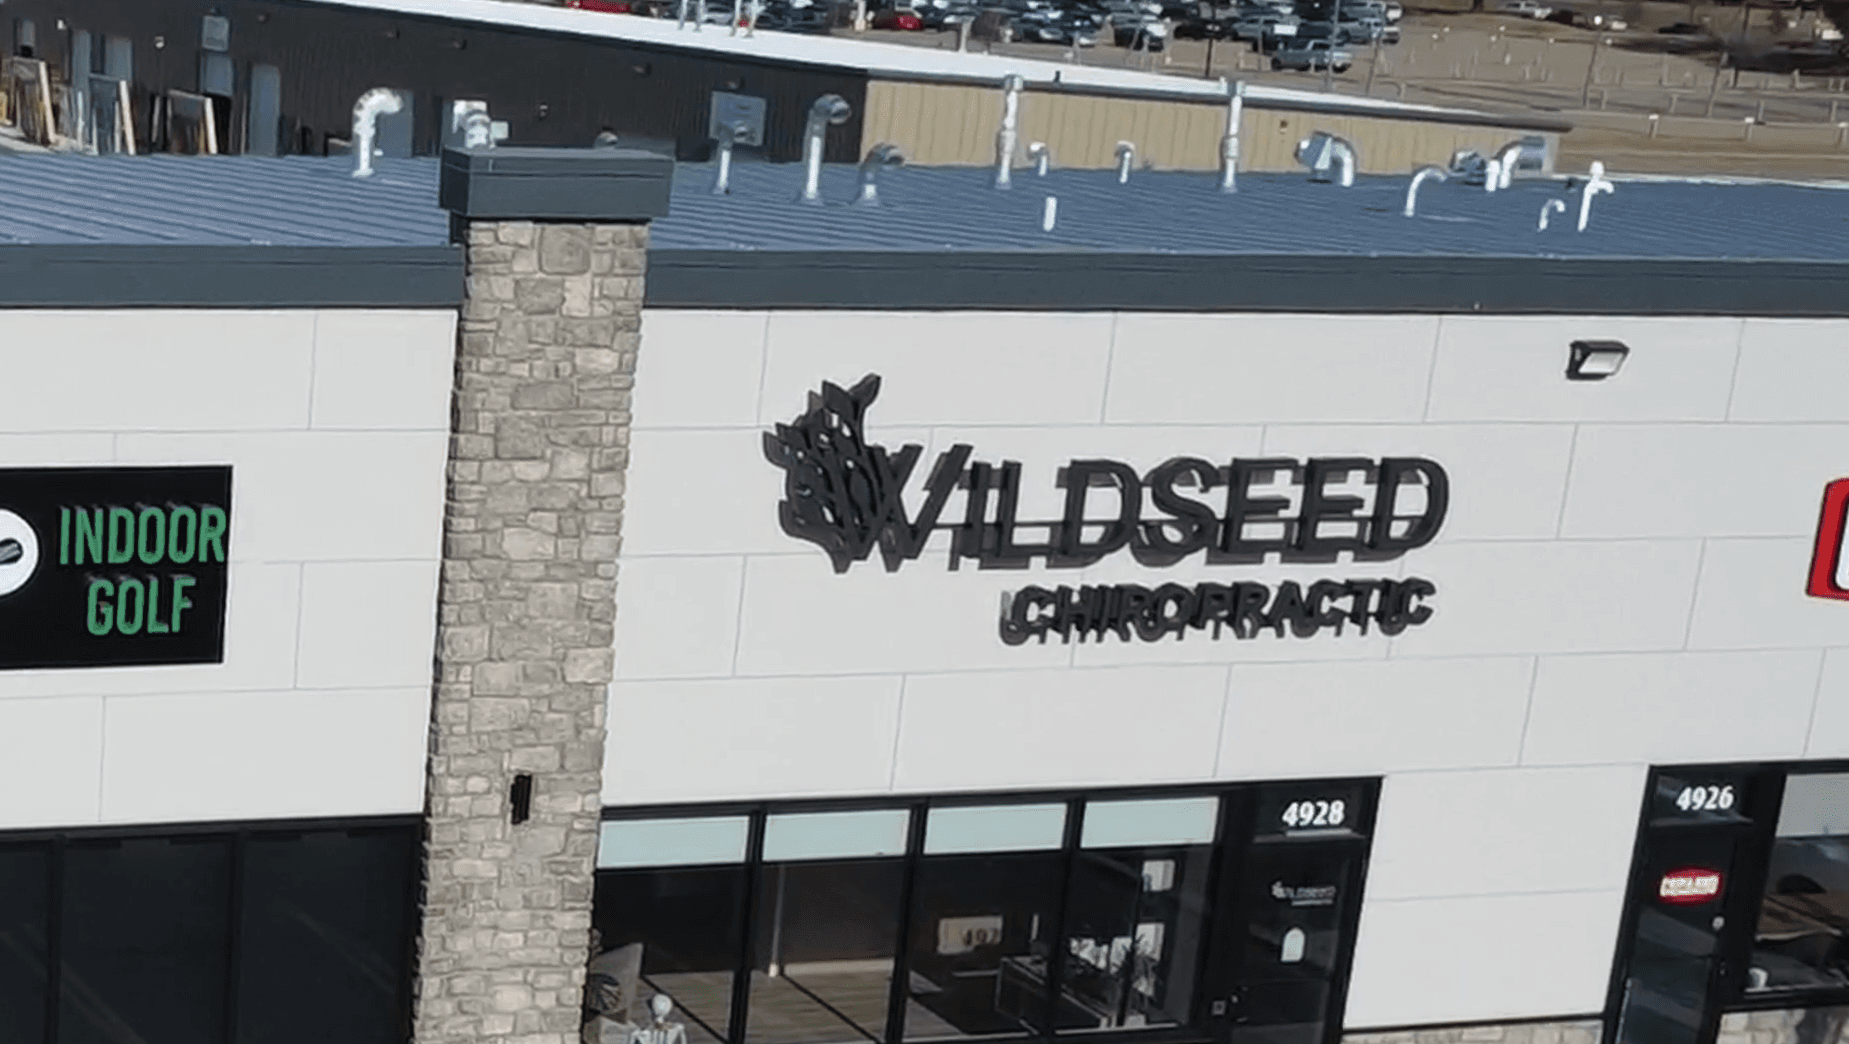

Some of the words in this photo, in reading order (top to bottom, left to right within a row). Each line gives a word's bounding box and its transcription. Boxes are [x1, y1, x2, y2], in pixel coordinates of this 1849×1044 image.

[812, 444, 1450, 562] WILDSEED
[59, 504, 227, 566] INDOOR
[86, 575, 197, 636] GOLF
[1002, 579, 1437, 641] CHIROPRACTIC
[1282, 800, 1345, 826] 4928
[1675, 785, 1734, 811] 4926
